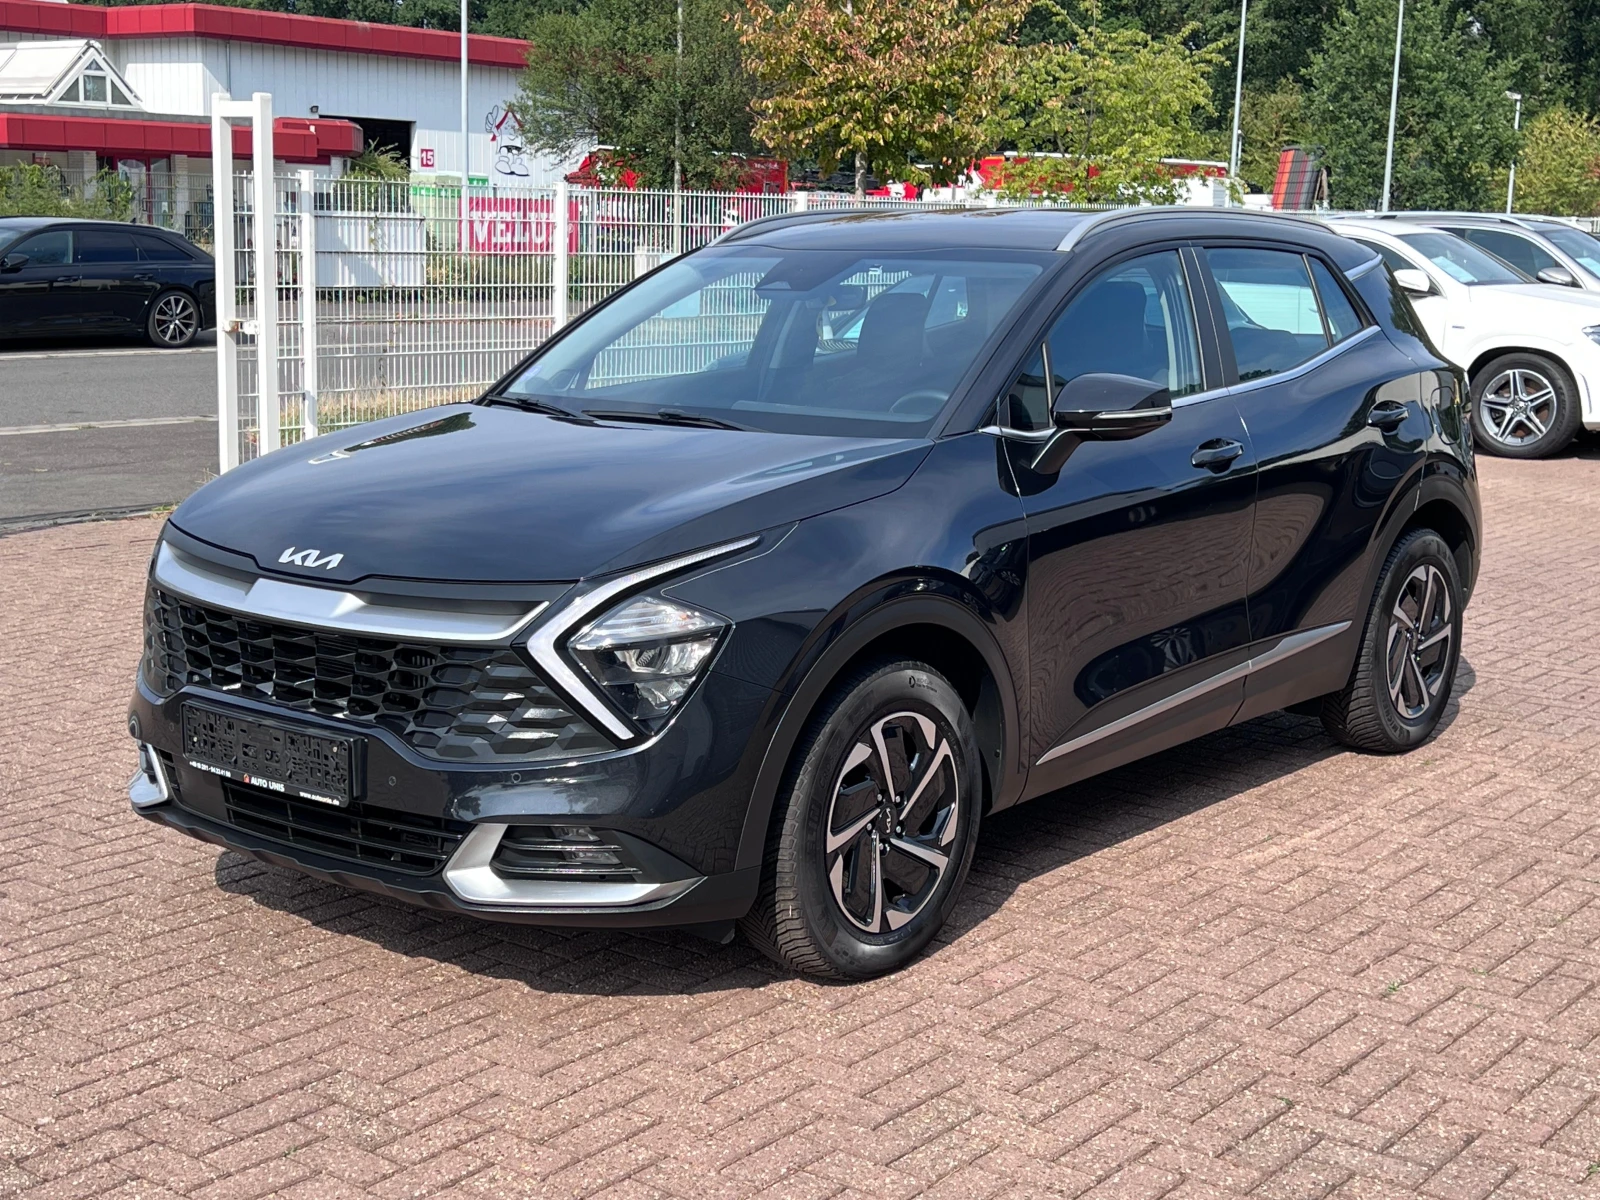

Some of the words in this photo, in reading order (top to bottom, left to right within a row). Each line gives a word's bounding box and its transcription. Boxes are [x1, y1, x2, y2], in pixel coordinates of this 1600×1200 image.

[421, 151, 434, 165] 15
[278, 546, 344, 570] KIA
[251, 776, 267, 788] AUTO
[269, 781, 285, 792] UNIS
